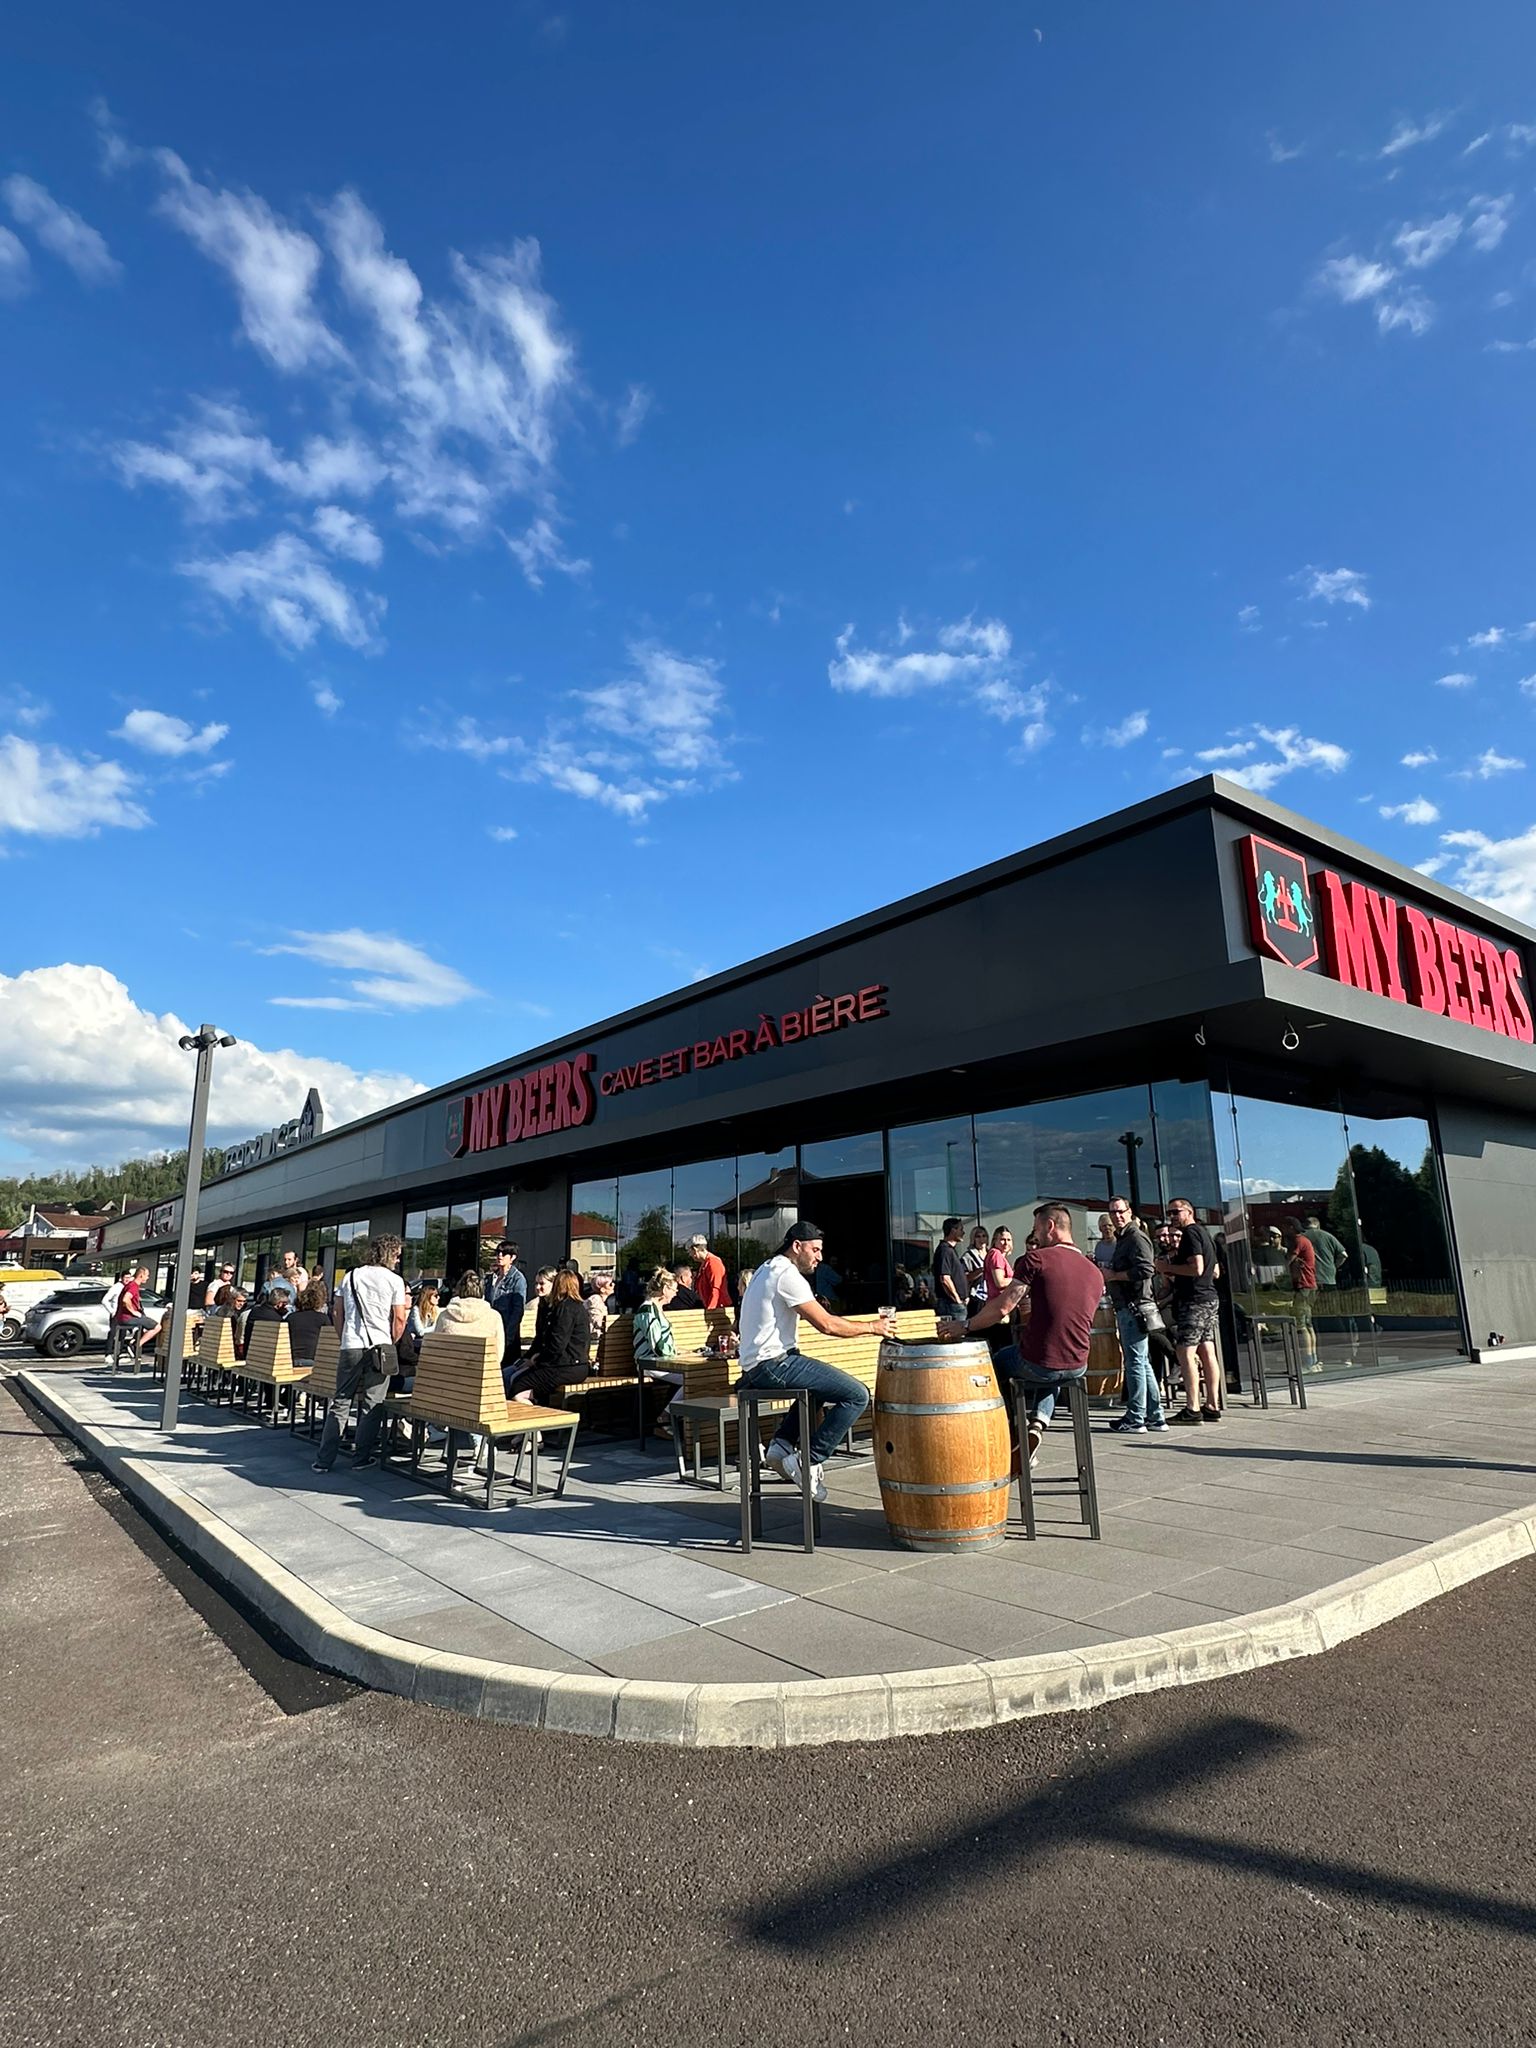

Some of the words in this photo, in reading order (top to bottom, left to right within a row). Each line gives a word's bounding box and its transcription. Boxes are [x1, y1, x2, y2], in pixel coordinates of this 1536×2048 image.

[1322, 868, 1407, 1004] MY
[1403, 905, 1535, 1045] BEERS
[600, 1058, 654, 1096] CAVE
[659, 1046, 690, 1080] ET
[693, 1029, 748, 1069] BAR
[754, 1013, 777, 1051] À
[780, 984, 882, 1044] BIÈRE
[468, 1083, 504, 1153] MY
[506, 1052, 589, 1143] BEERS
